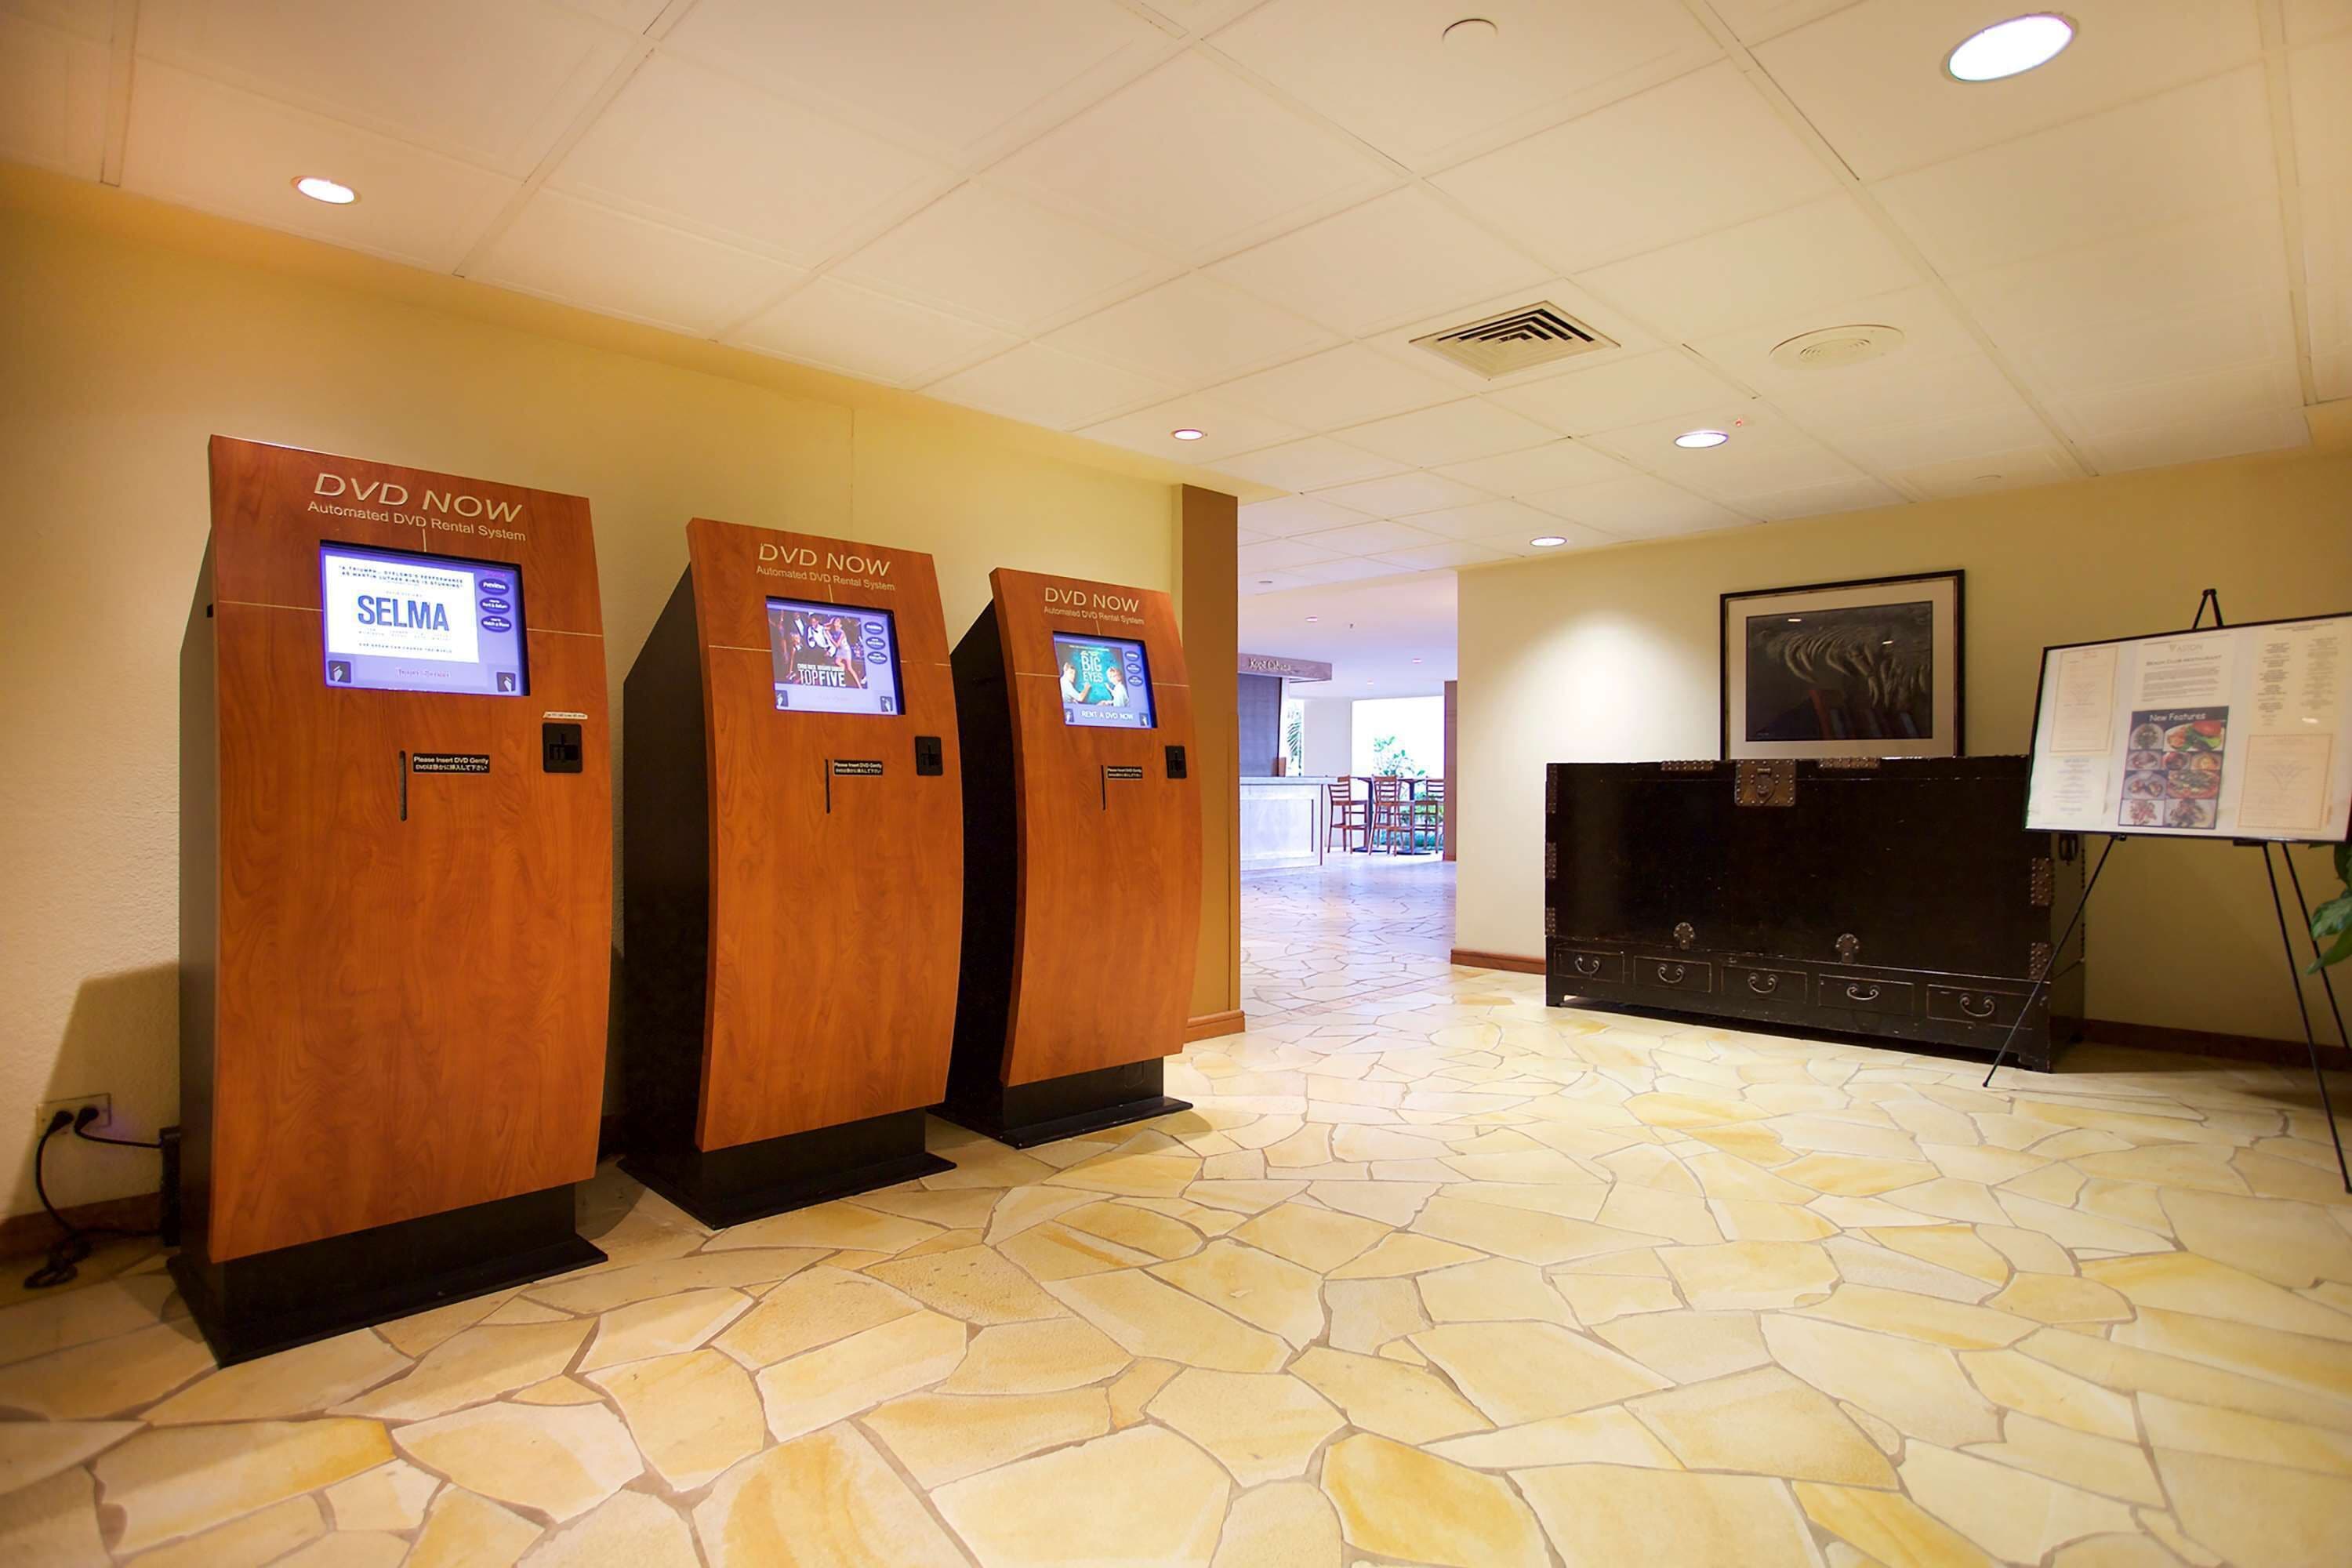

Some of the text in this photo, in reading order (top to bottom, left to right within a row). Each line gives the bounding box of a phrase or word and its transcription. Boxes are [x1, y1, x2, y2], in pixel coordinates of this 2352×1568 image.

[314, 473, 522, 523] DVD NOW
[307, 501, 527, 542] Automated DVD Rental System
[759, 543, 891, 576] DVD NOW
[757, 565, 895, 590] Automated DVD Rental System
[358, 595, 449, 631] SELMA
[1045, 587, 1139, 613] DVD NOW
[1044, 606, 1145, 625] Automated DVD Rental System
[1081, 655, 1102, 672] BIG
[1083, 672, 1103, 683] EYES
